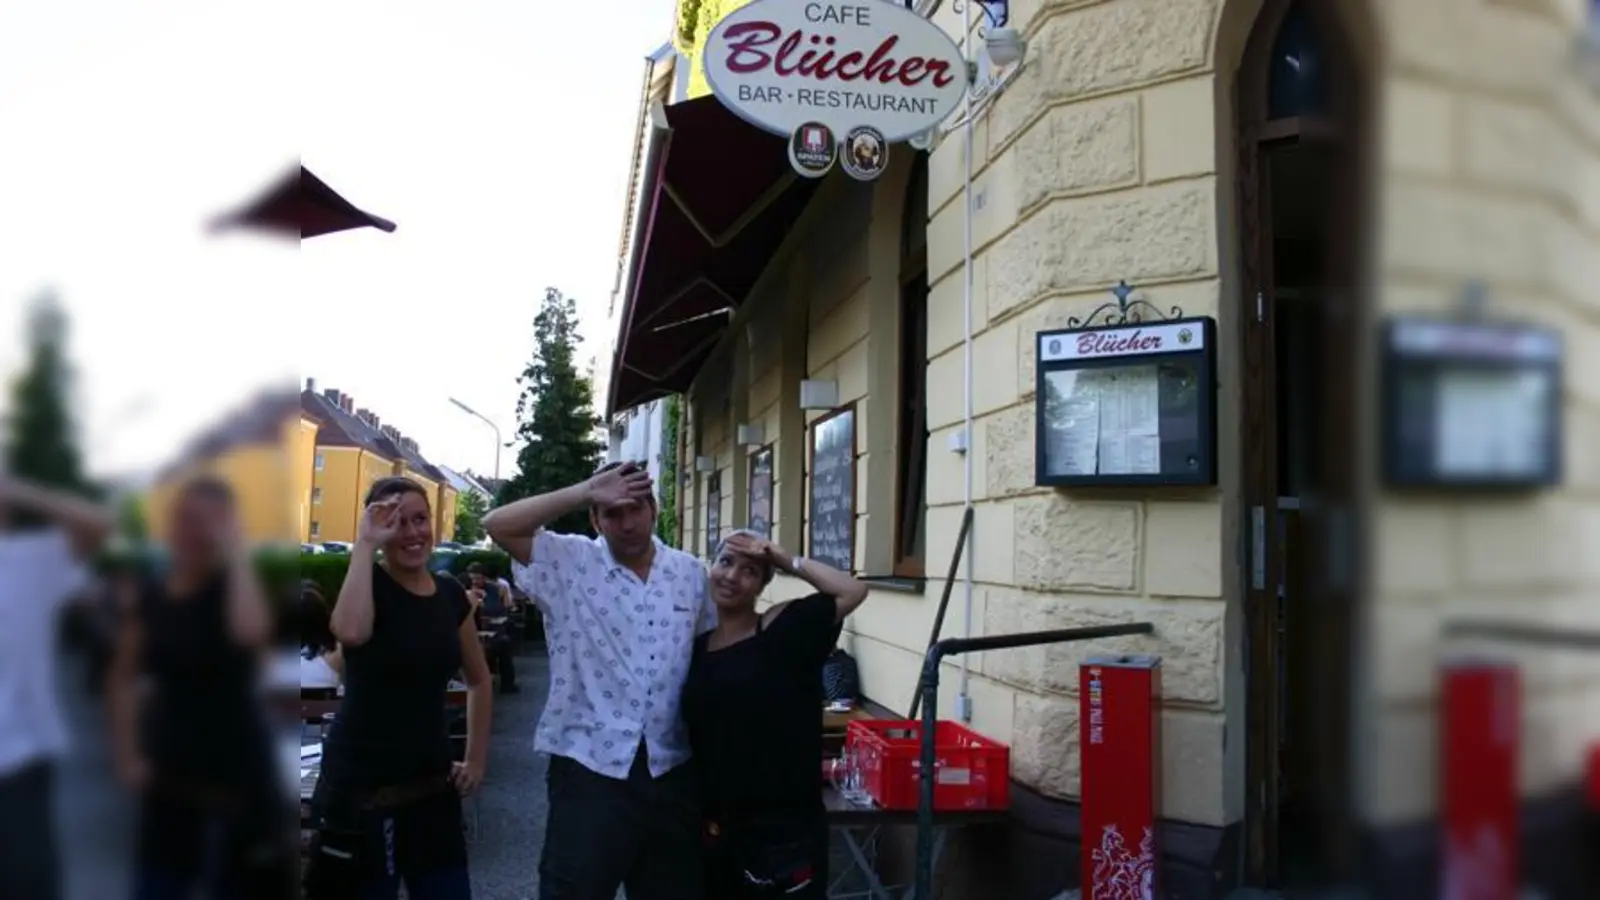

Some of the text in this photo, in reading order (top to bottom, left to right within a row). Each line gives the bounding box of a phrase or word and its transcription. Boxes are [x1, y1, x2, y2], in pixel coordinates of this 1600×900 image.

[804, 3, 871, 26] CAFE
[722, 21, 955, 89] Blücher
[738, 85, 939, 115] BAR RESTAURANT
[1075, 329, 1164, 356] Blücher
